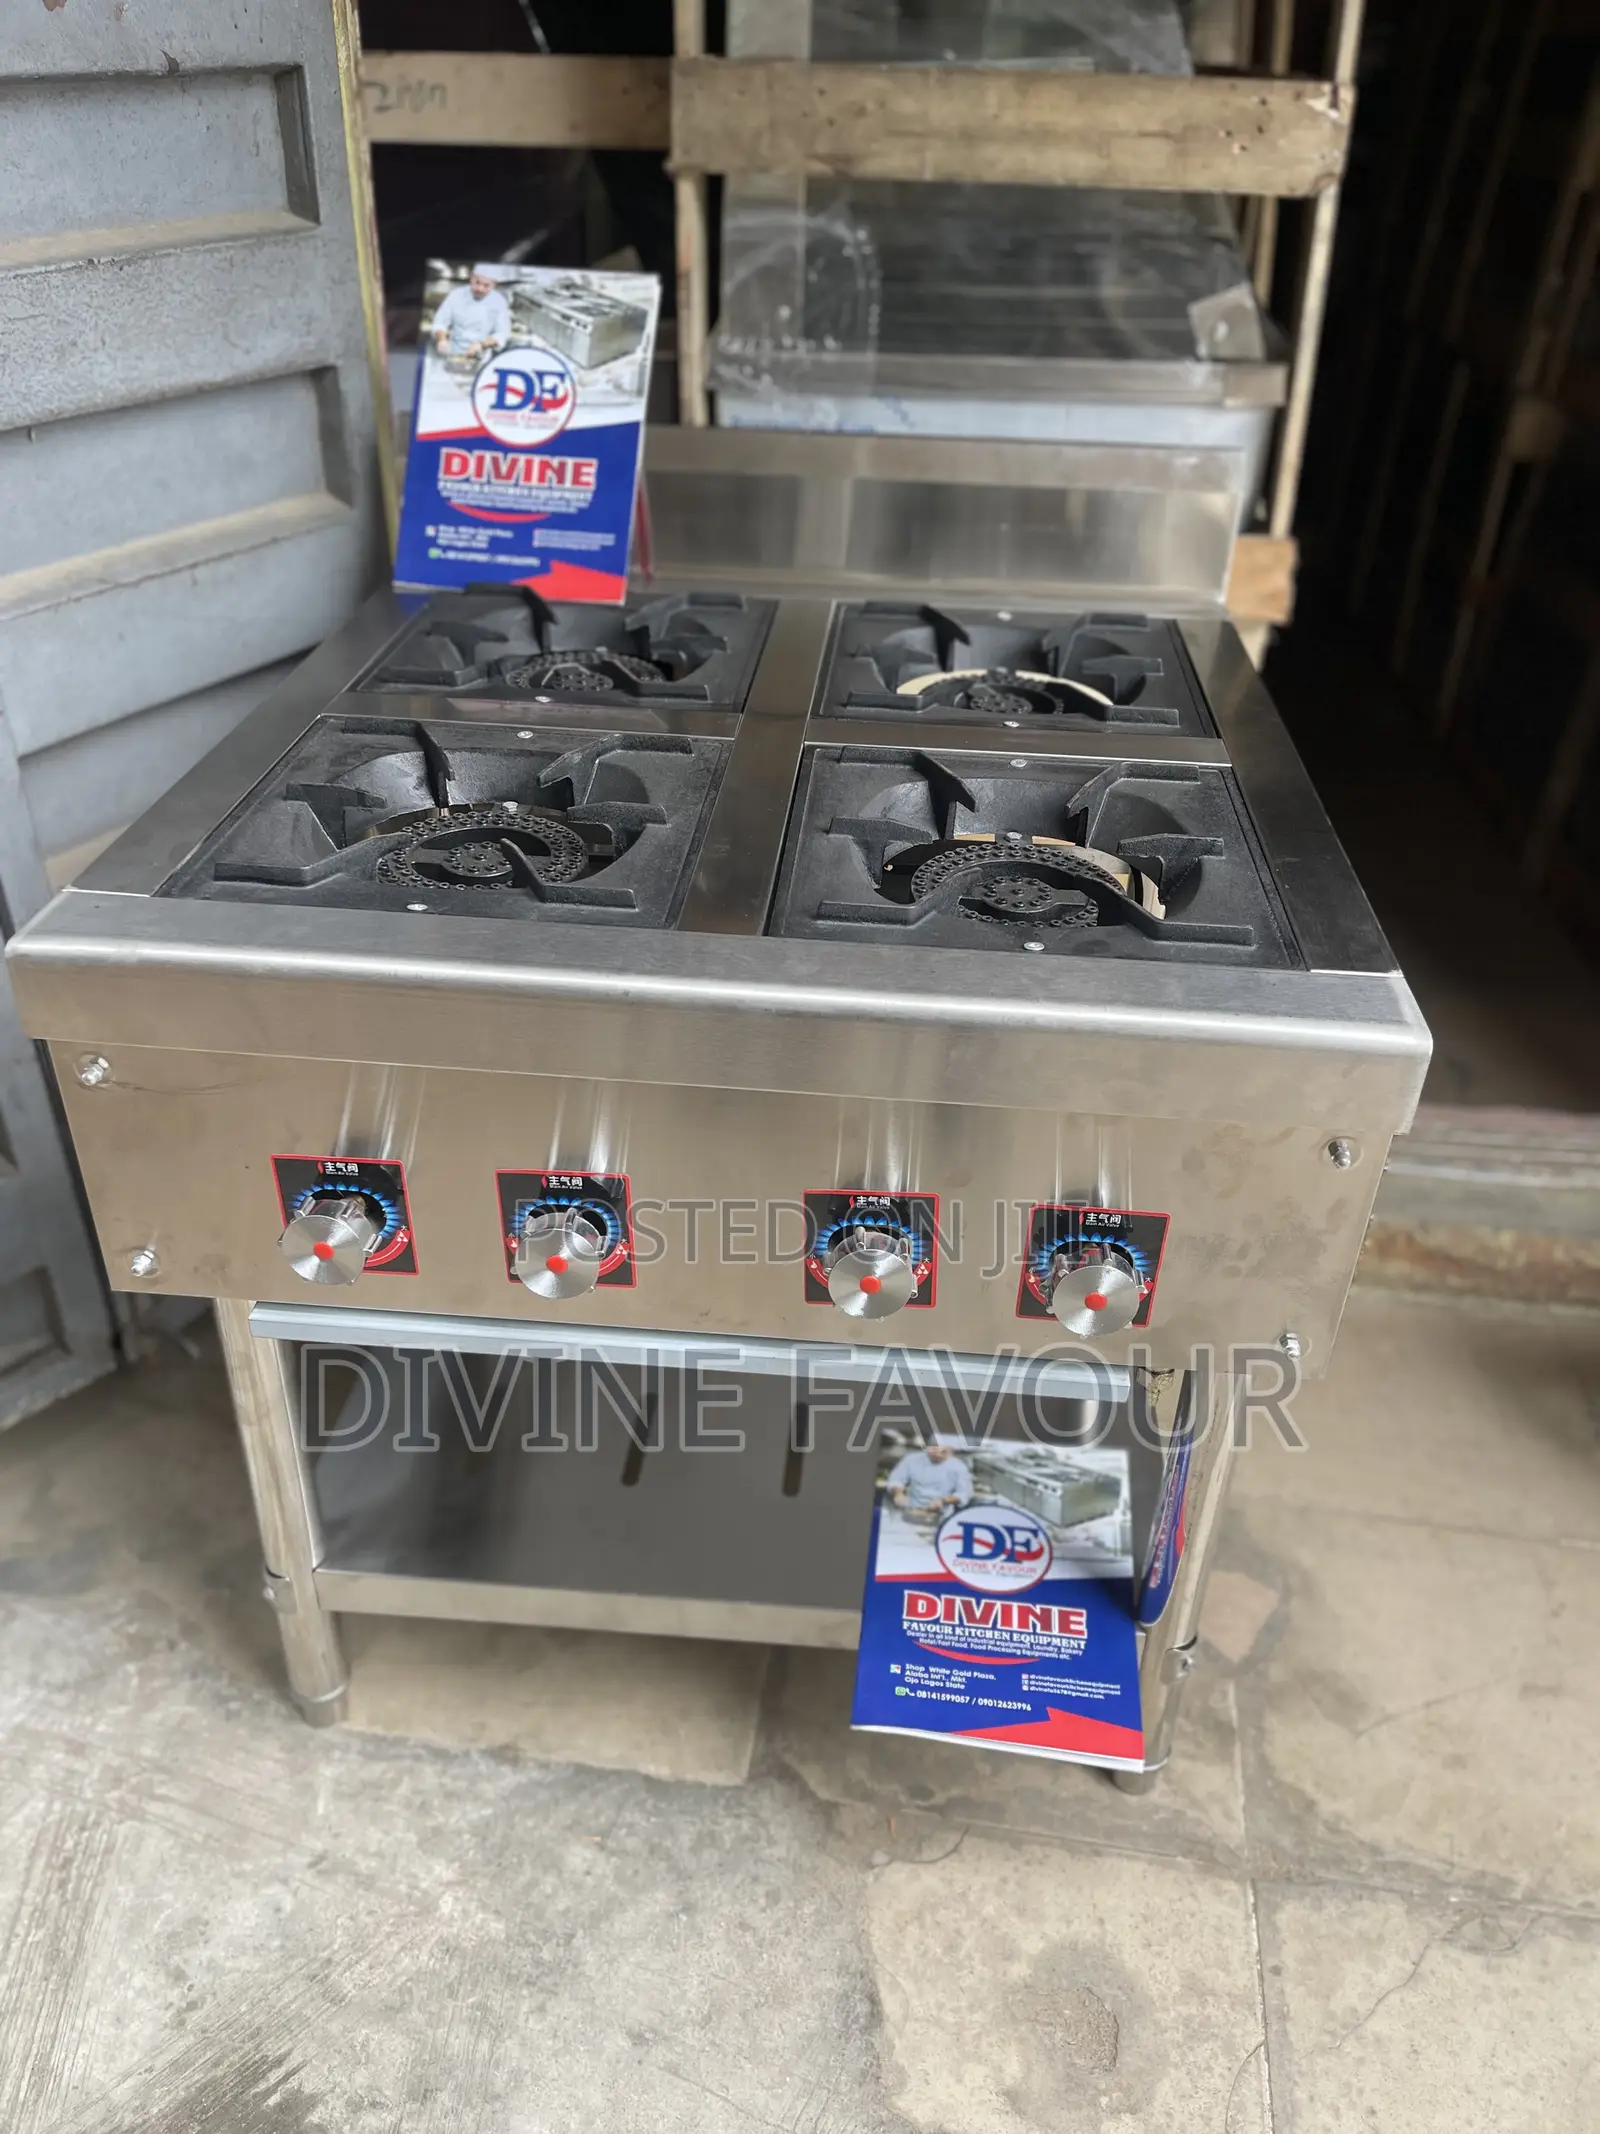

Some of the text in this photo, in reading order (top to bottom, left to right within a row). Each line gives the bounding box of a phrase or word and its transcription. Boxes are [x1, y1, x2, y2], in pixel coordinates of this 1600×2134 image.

[490, 367, 566, 414] DF
[438, 447, 599, 491] DIVINE
[956, 1520, 1040, 1565] DF
[902, 1590, 1088, 1640] DIVINE
[903, 1620, 1087, 1650] FAVOUR KITCHEN EQUIPMENT
[906, 1630, 928, 1638] Dealer
[1060, 1648, 1084, 1657] Bakery
[988, 1645, 1022, 1656] Processing
[1022, 1649, 1058, 1659] Equipments
[904, 1671, 929, 1679] Alaba
[904, 1677, 966, 1690] Ojo Lagos State
[905, 1664, 926, 1673] Shop
[952, 1670, 972, 1678] Gold
[916, 1690, 971, 1705] 08141599057
[978, 1698, 1032, 1712] 09012623996
